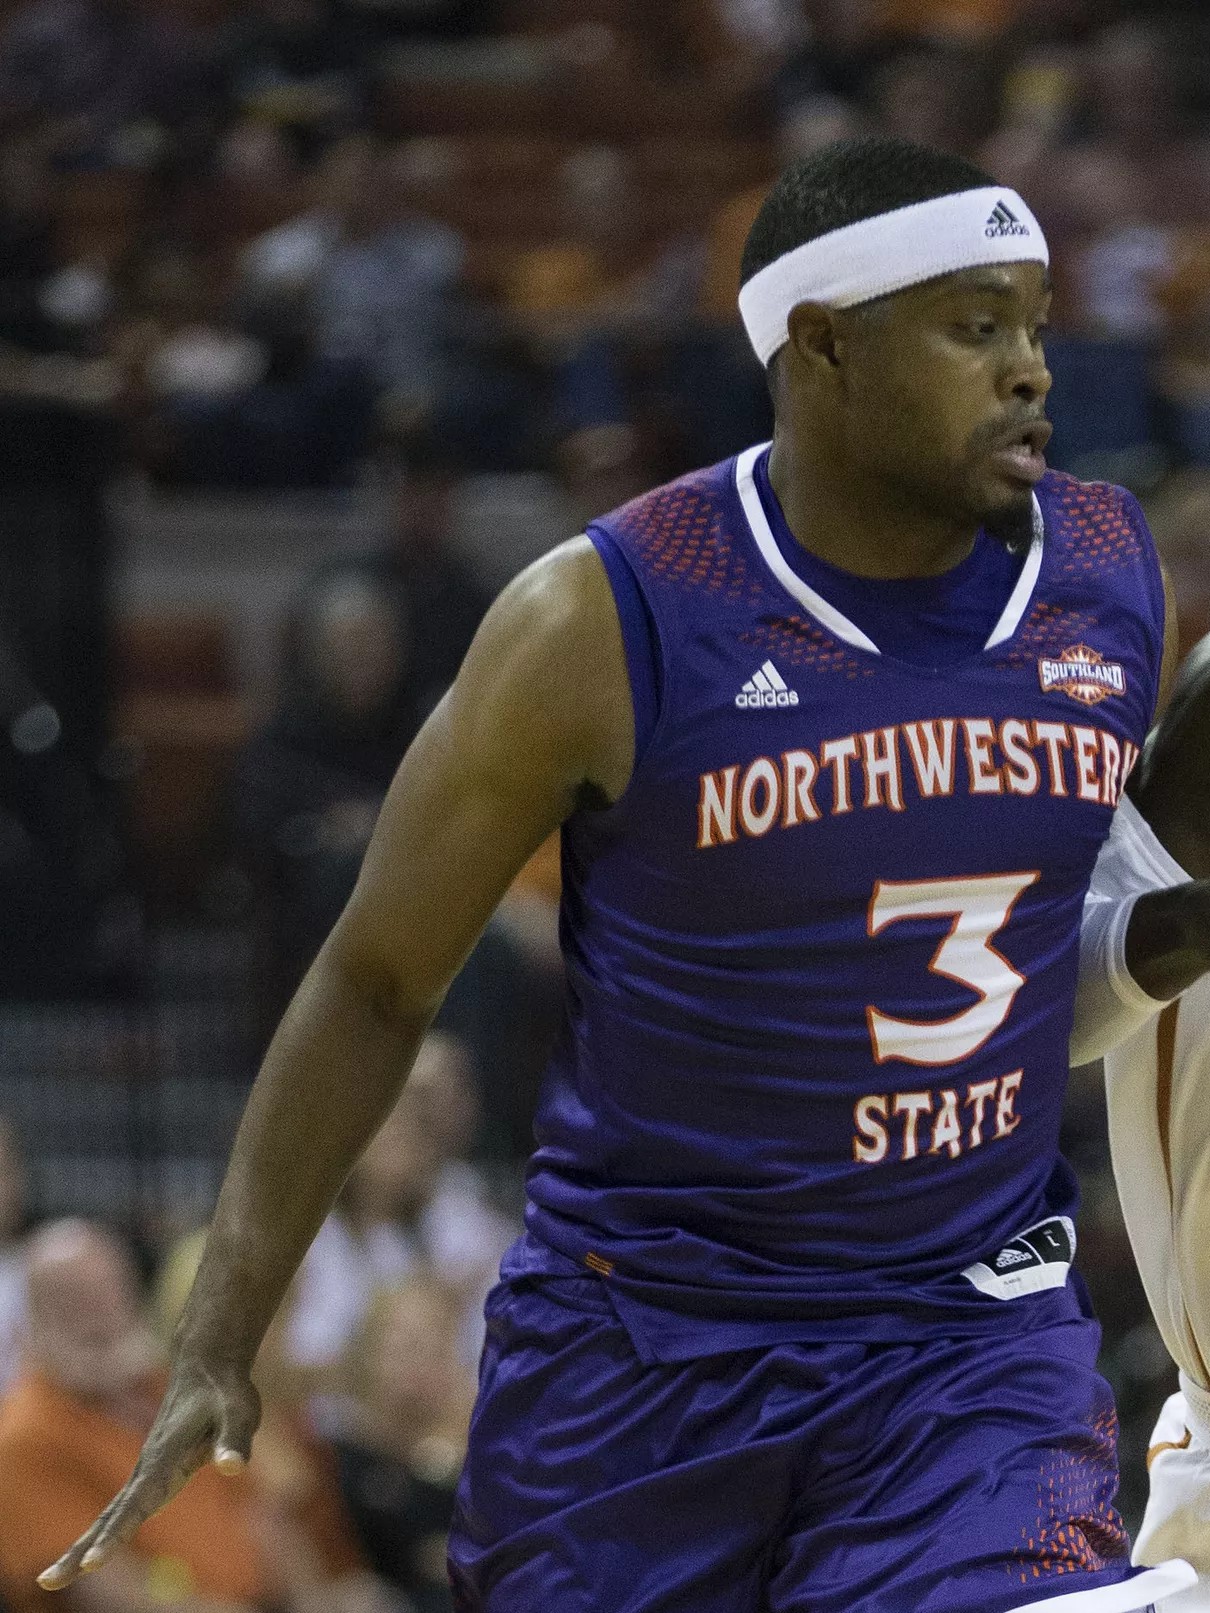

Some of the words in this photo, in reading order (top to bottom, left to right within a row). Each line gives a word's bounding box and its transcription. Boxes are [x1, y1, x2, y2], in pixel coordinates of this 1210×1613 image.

[984, 222, 1030, 238] adidas
[1041, 660, 1124, 691] SOUTHLAND
[735, 689, 799, 708] adidas
[866, 870, 1041, 1066] 3
[852, 1069, 1024, 1163] STATE
[996, 1252, 1033, 1268] adidas
